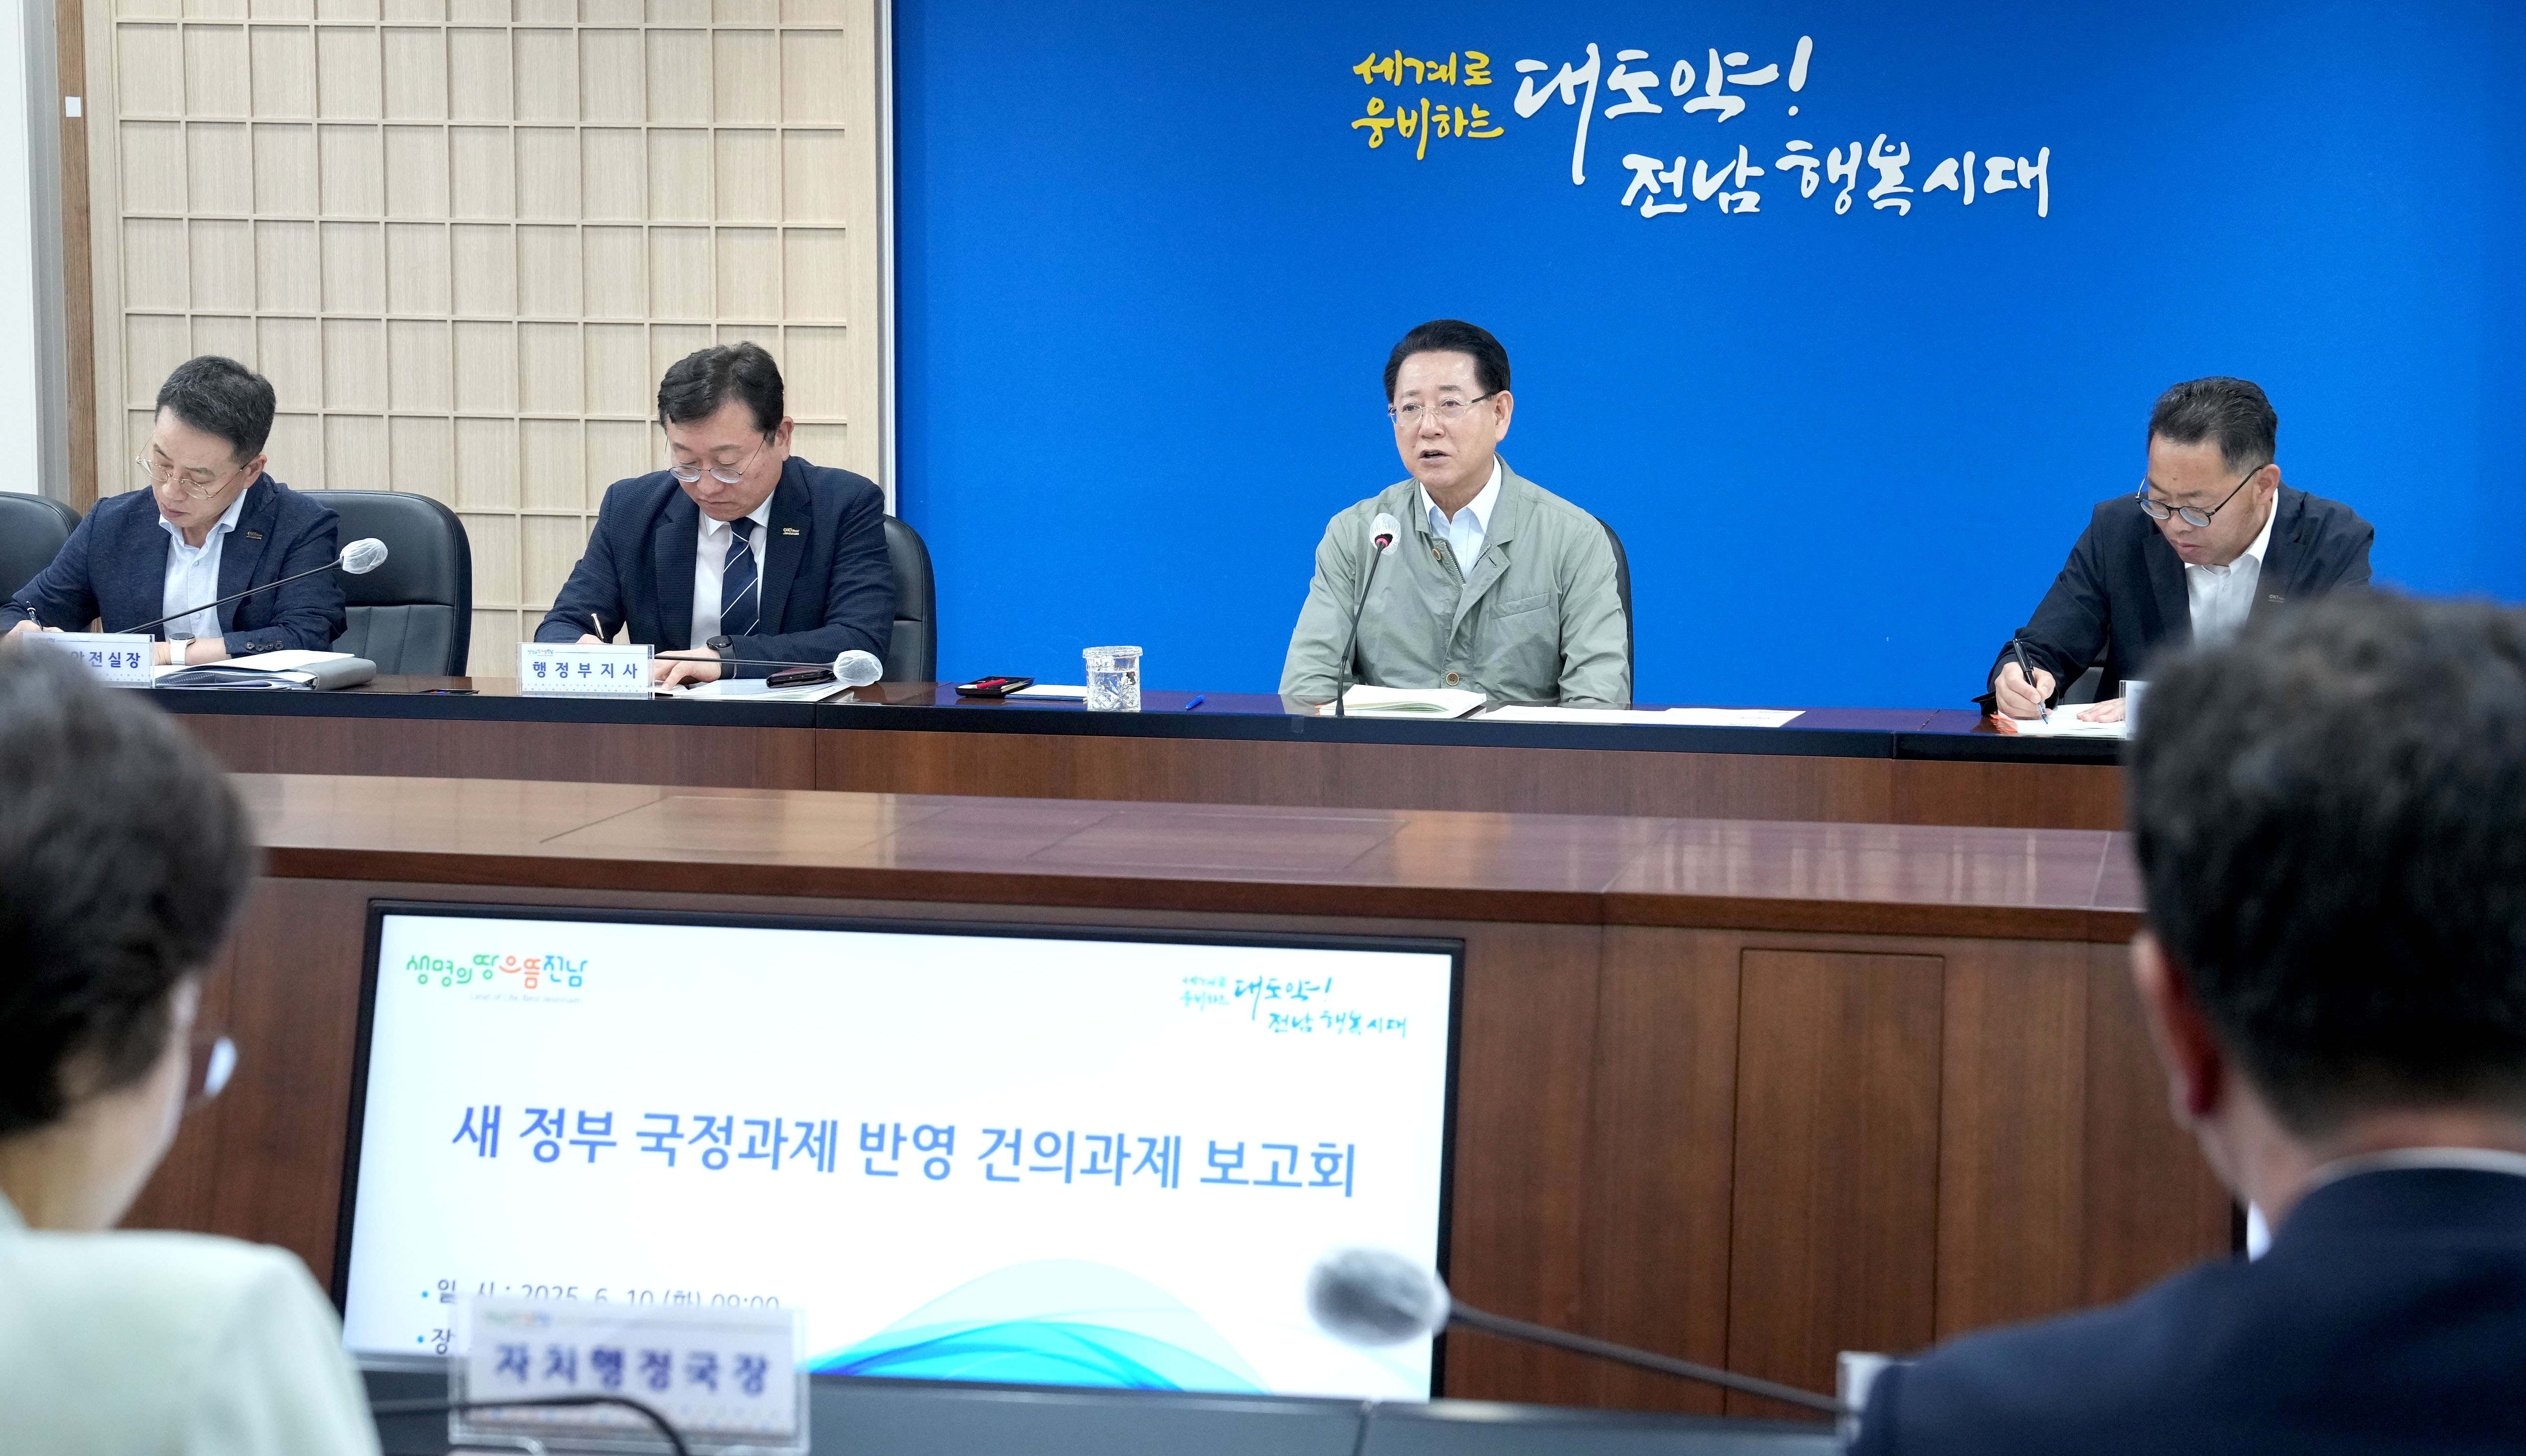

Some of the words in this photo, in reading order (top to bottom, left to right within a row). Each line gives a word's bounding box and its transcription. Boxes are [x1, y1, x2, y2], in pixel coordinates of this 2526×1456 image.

[1353, 50, 1492, 86] 세계로
[1352, 97, 1504, 160] 웅비하는
[1514, 35, 1813, 185] 대도약!
[1621, 144, 1764, 218] 전남
[1775, 133, 1914, 216] 행복
[1923, 147, 2050, 218] 시대
[532, 661, 638, 679] 행정부지사
[543, 955, 588, 987] 전남
[1268, 1012, 1314, 1033] 전남
[1366, 1017, 1407, 1039] 시대
[452, 1105, 501, 1159] 새
[519, 1107, 618, 1164] 정부
[635, 1113, 838, 1173] 국정과제
[859, 1123, 956, 1181] 반영
[977, 1128, 1181, 1189] 건의과제
[1199, 1140, 1355, 1198] 보고회
[495, 1343, 769, 1398] 자치행정국장
